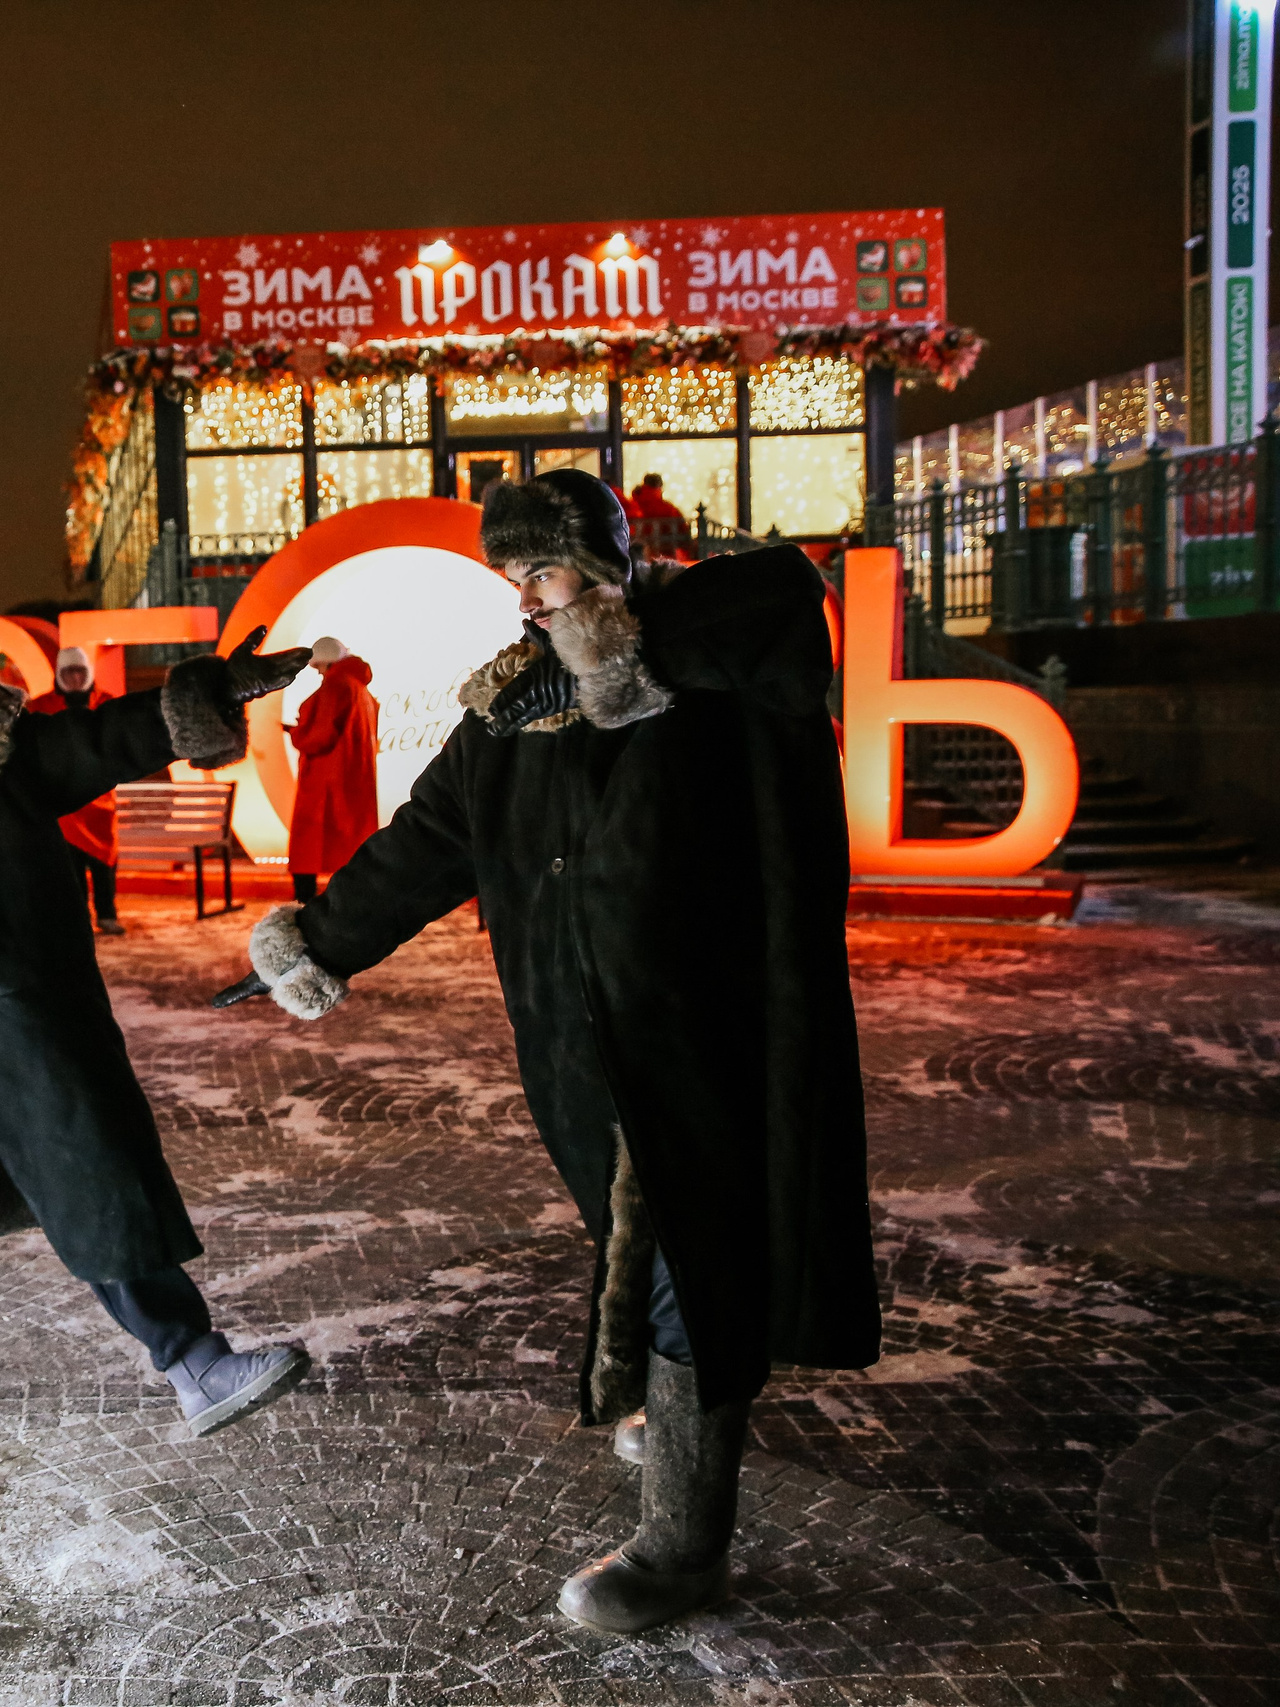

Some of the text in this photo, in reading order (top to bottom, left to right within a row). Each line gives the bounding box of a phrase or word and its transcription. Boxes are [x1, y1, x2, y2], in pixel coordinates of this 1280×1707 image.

[1231, 163, 1251, 226] 2025
[221, 264, 374, 307] ЗИМА
[687, 245, 839, 288] ЗИМА
[394, 253, 665, 327] ПРОКАТ
[688, 286, 840, 314] В МОСКВЕ
[222, 304, 375, 332] В МОСКВЕ
[1230, 362, 1248, 397] НА
